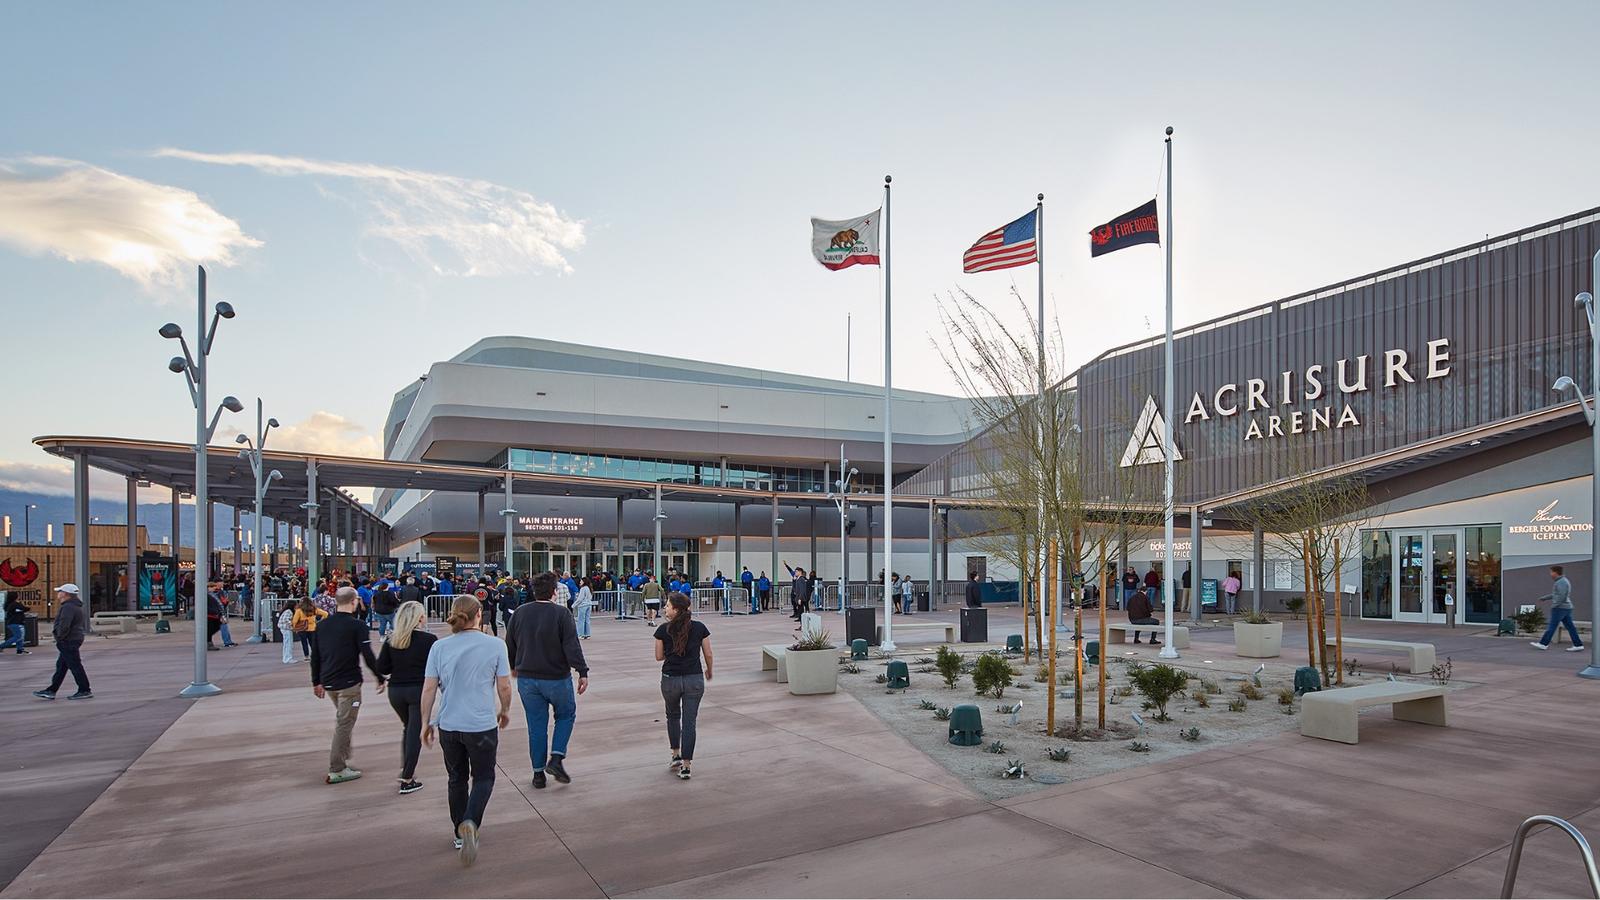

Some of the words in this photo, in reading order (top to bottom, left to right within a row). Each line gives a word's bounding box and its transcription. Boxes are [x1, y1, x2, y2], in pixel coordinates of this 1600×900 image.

[1115, 215, 1157, 238] FIREBIRDS
[1184, 338, 1452, 425] ACRISURE
[1244, 403, 1361, 441] ARENA
[542, 517, 584, 525] ENTRANCE
[1509, 525, 1539, 533] BERGER
[1540, 523, 1594, 532] FOUNDATION
[1533, 532, 1571, 541] ICEPLEX
